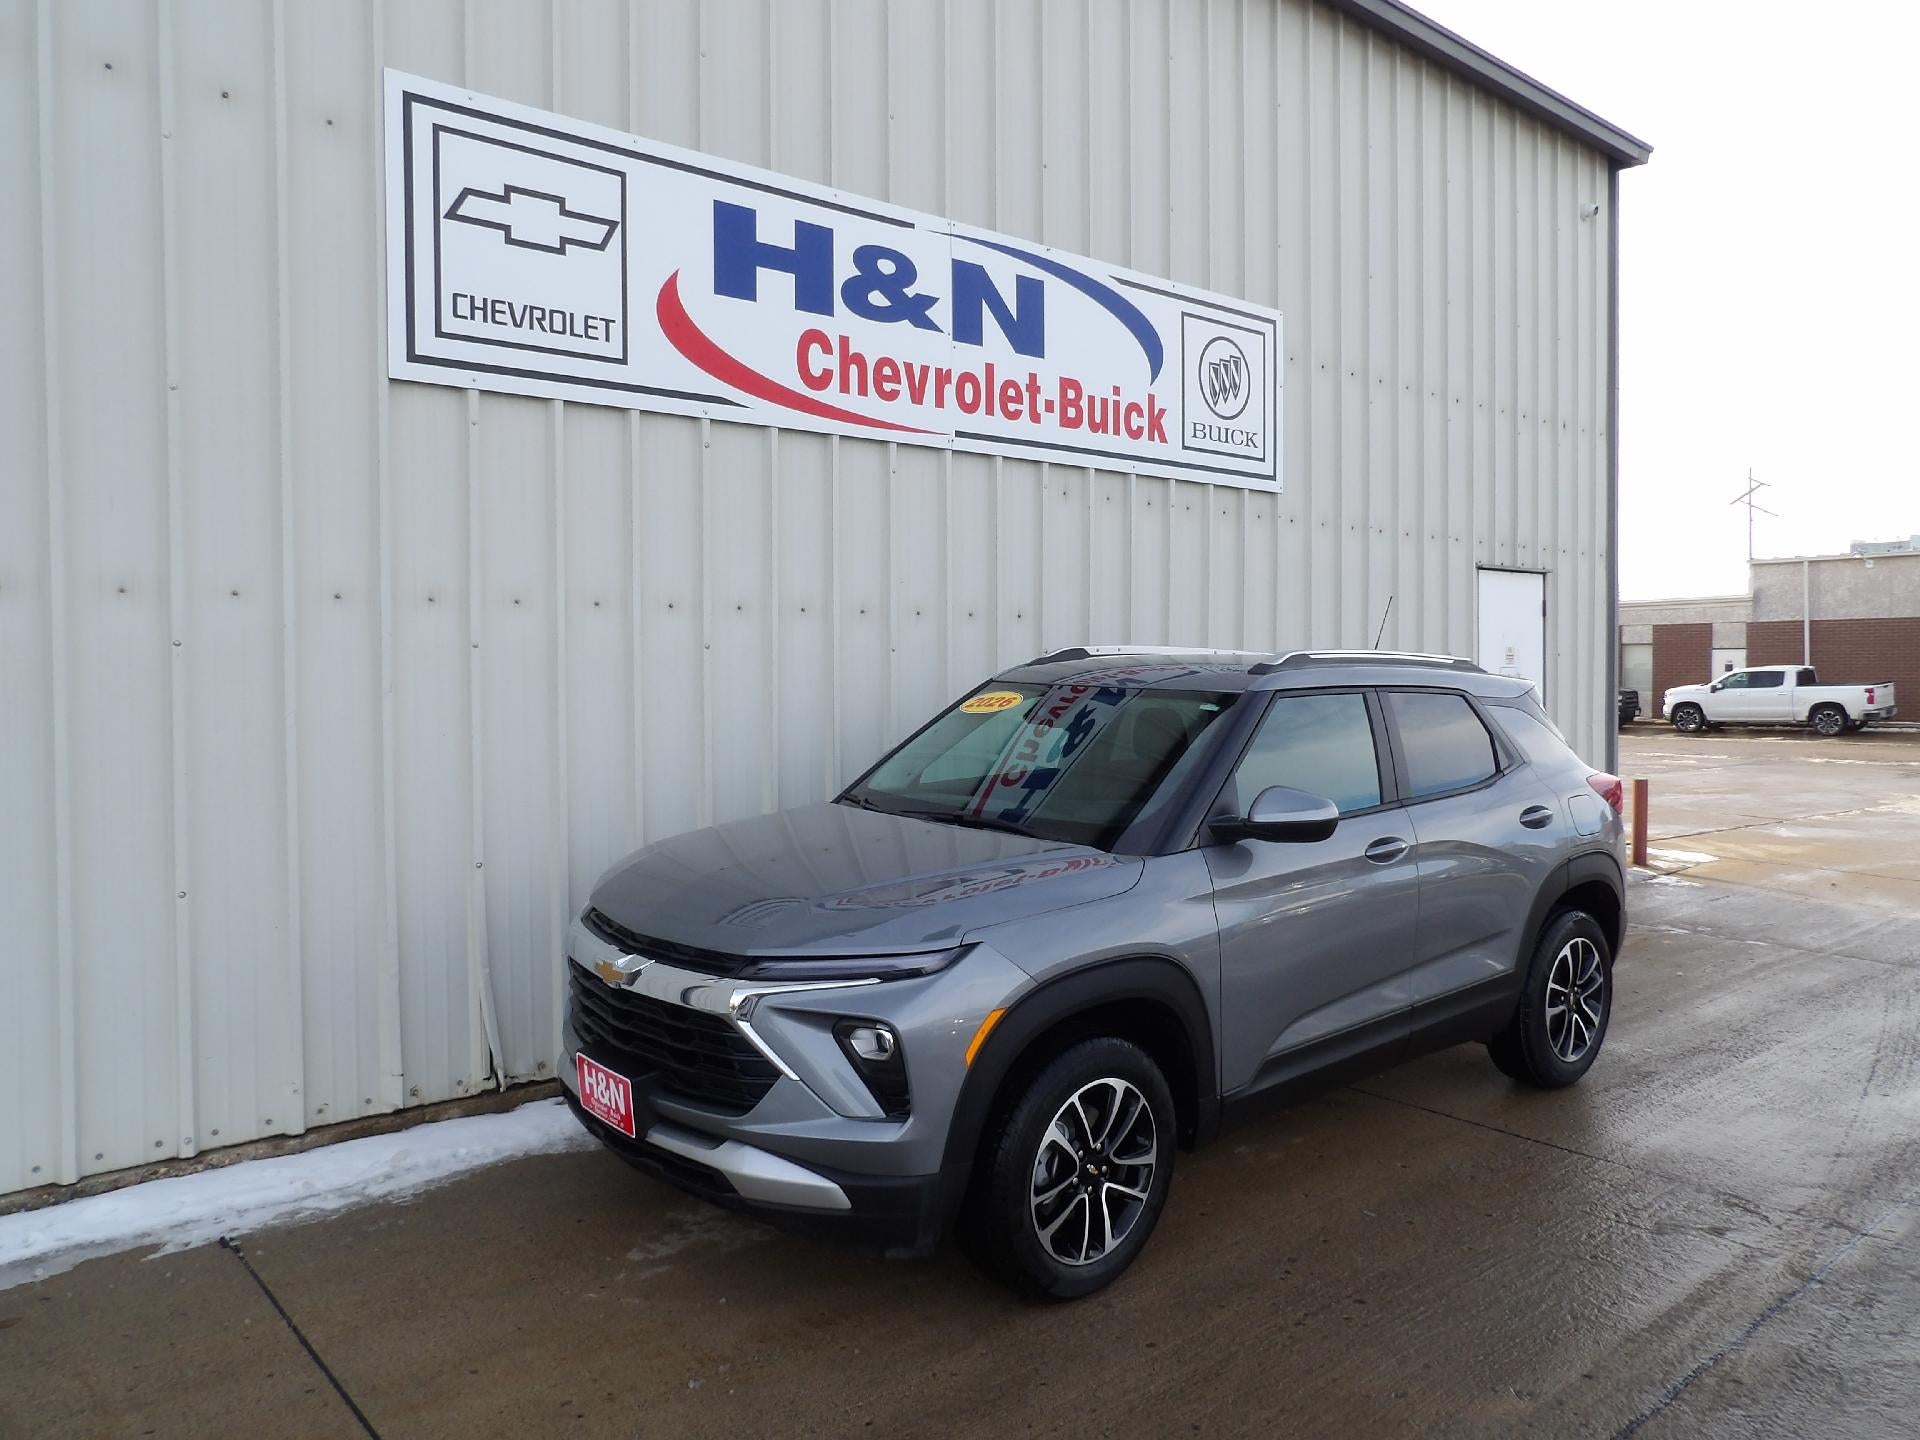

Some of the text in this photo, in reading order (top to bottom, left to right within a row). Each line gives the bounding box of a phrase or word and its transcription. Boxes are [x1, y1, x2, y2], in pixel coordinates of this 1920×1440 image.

[713, 199, 1046, 360] H&N
[452, 292, 616, 344] CHEVROLET
[796, 328, 1169, 445] Chevrolet-Buick
[1190, 421, 1259, 450] BUICK
[964, 696, 1018, 708] 2026
[583, 1063, 626, 1116] H&N
